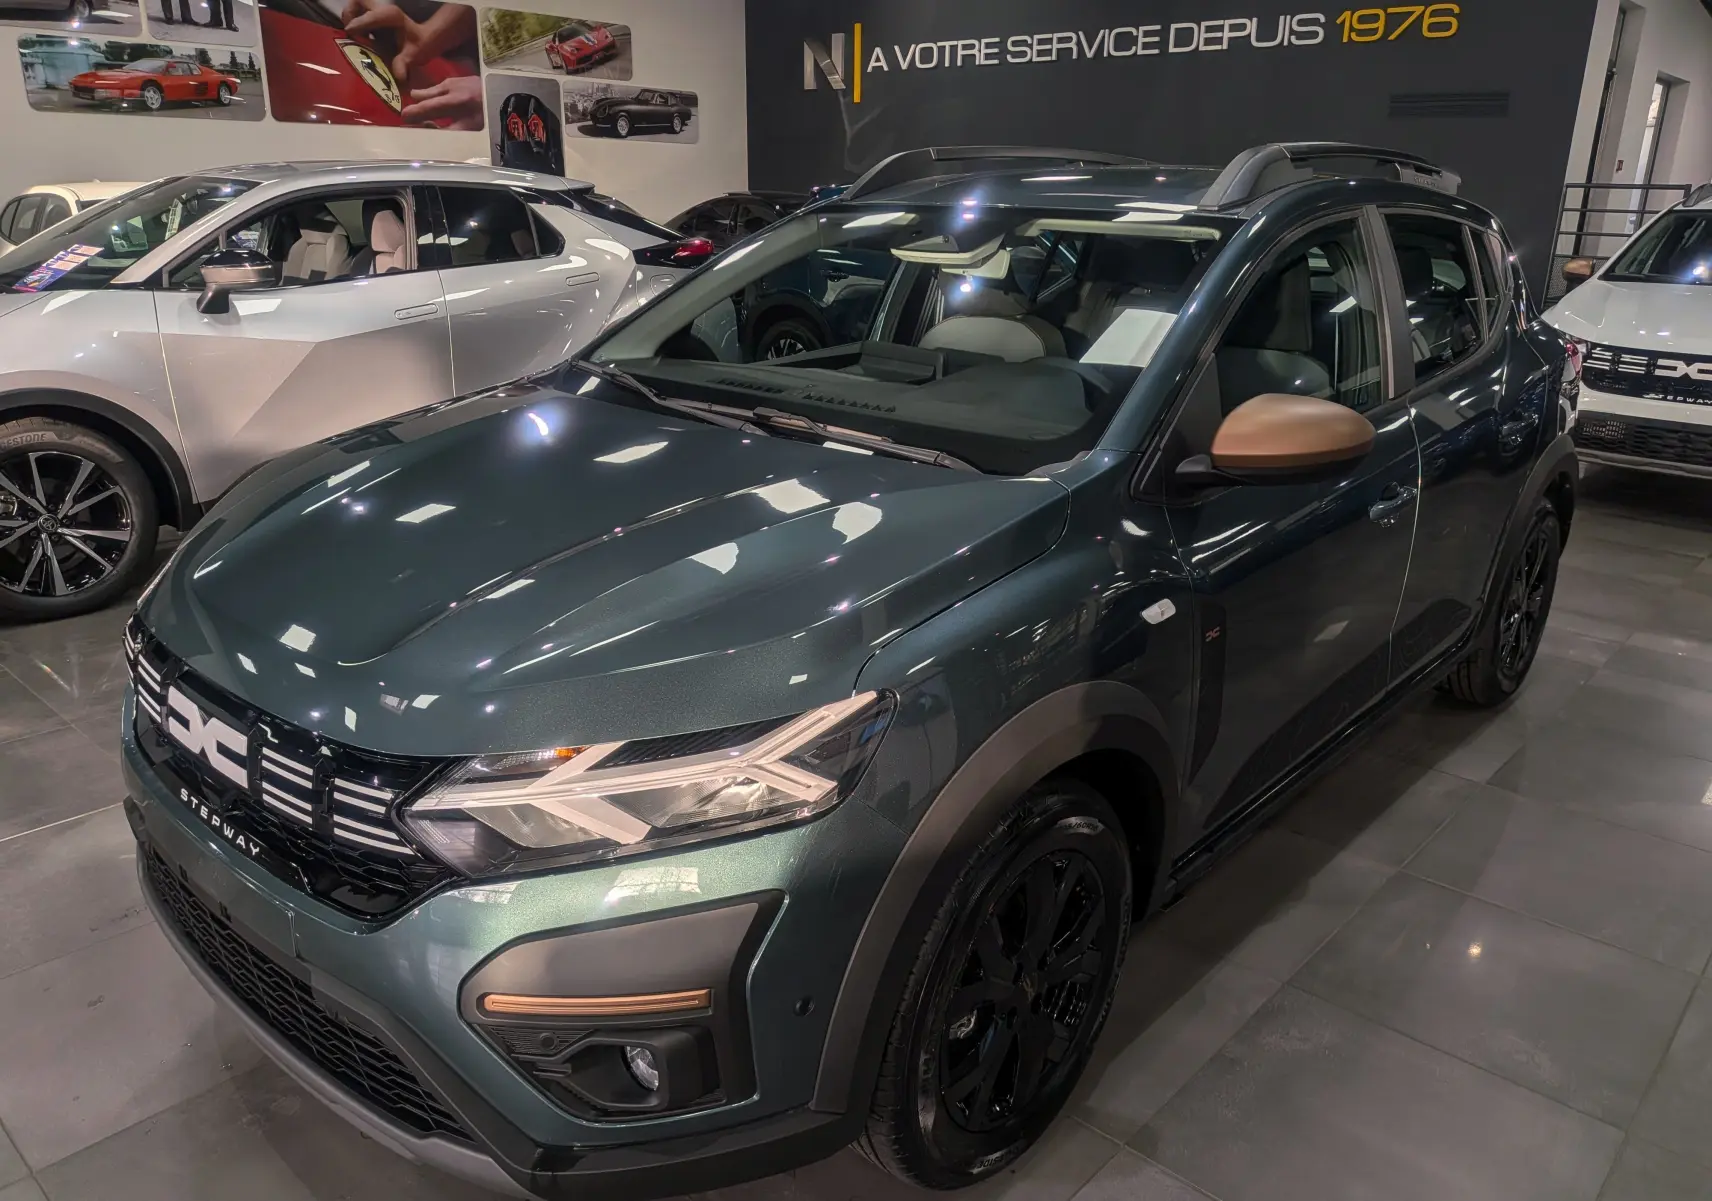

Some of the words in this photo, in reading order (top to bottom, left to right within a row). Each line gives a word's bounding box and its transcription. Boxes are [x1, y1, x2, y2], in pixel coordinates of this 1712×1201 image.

[866, 46, 890, 73] A
[893, 37, 1001, 71] VOTRE
[1006, 24, 1162, 63] SERVICE
[1168, 13, 1326, 53] DEPUIS
[1335, 3, 1461, 43] 1976
[180, 788, 260, 855] STEPWAY
